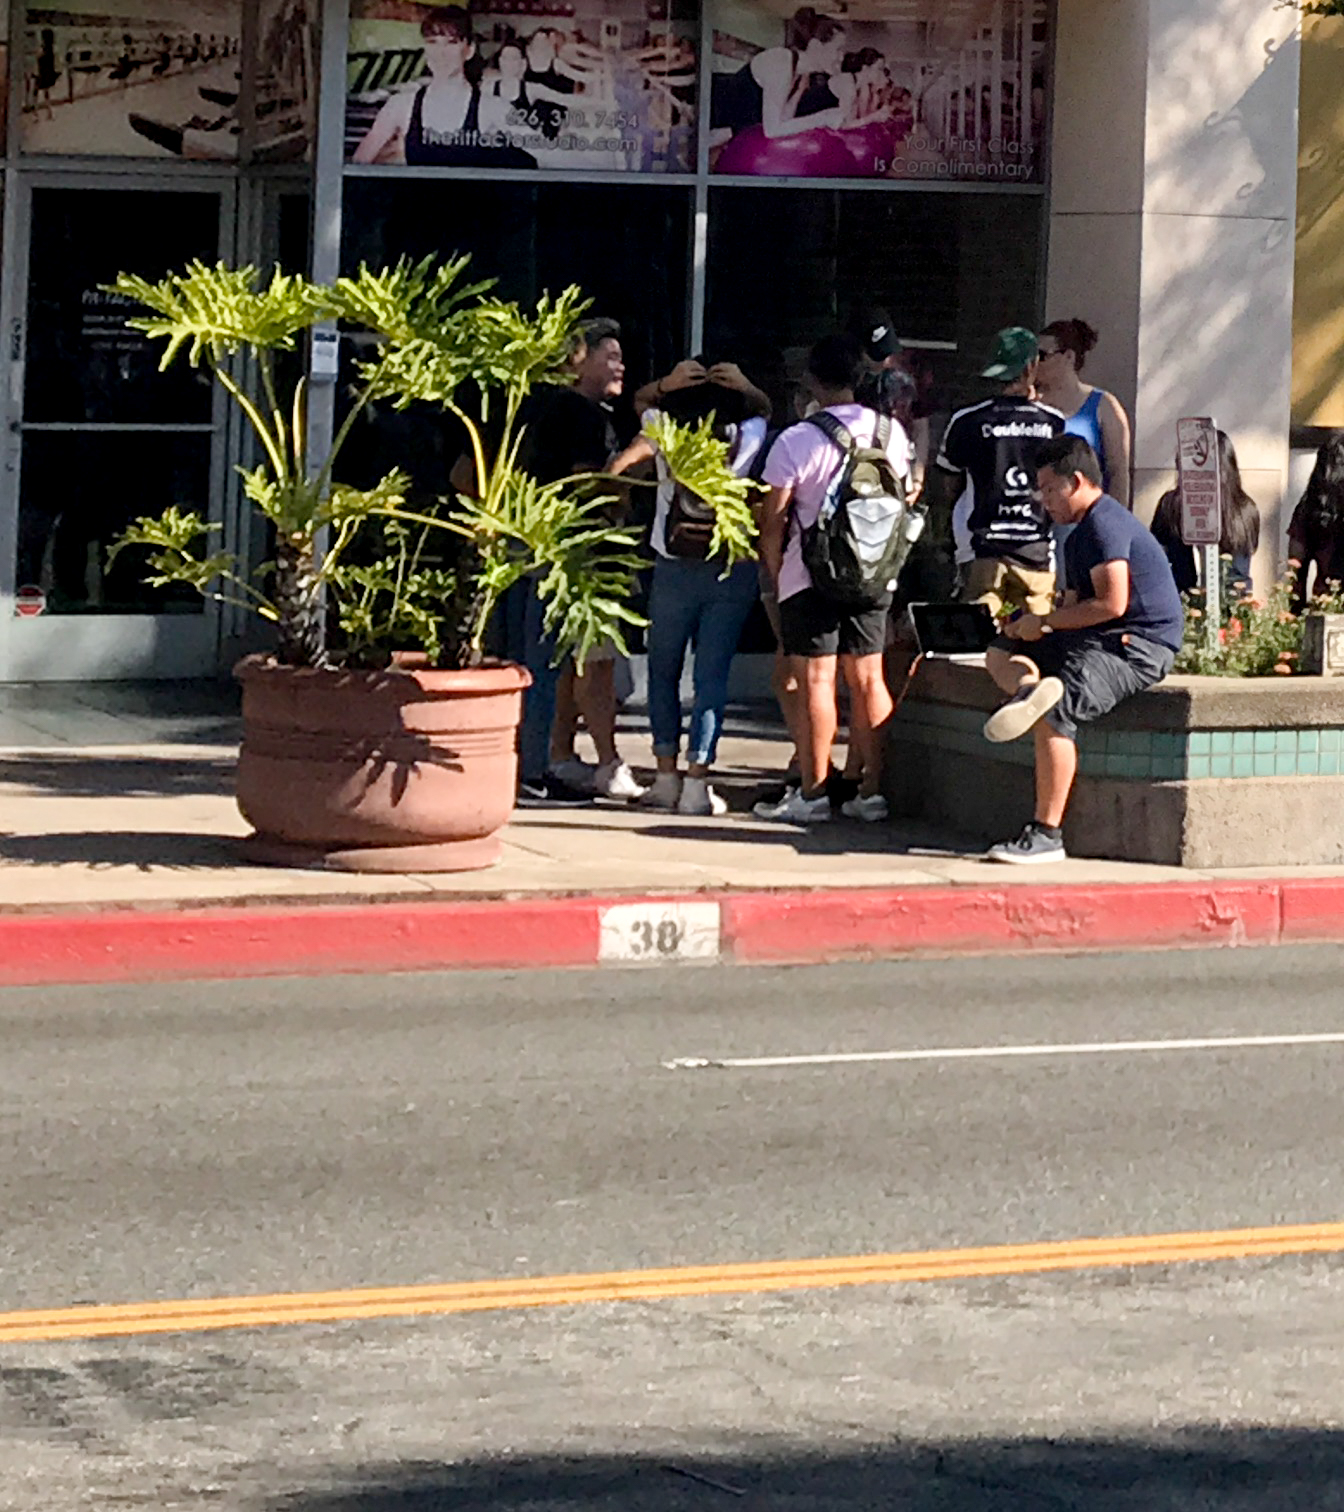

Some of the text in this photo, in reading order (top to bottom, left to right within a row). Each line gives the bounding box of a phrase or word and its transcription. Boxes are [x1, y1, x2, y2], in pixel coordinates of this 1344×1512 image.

[904, 134, 1034, 155] Your First Class
[874, 156, 1034, 179] Is Complimentary
